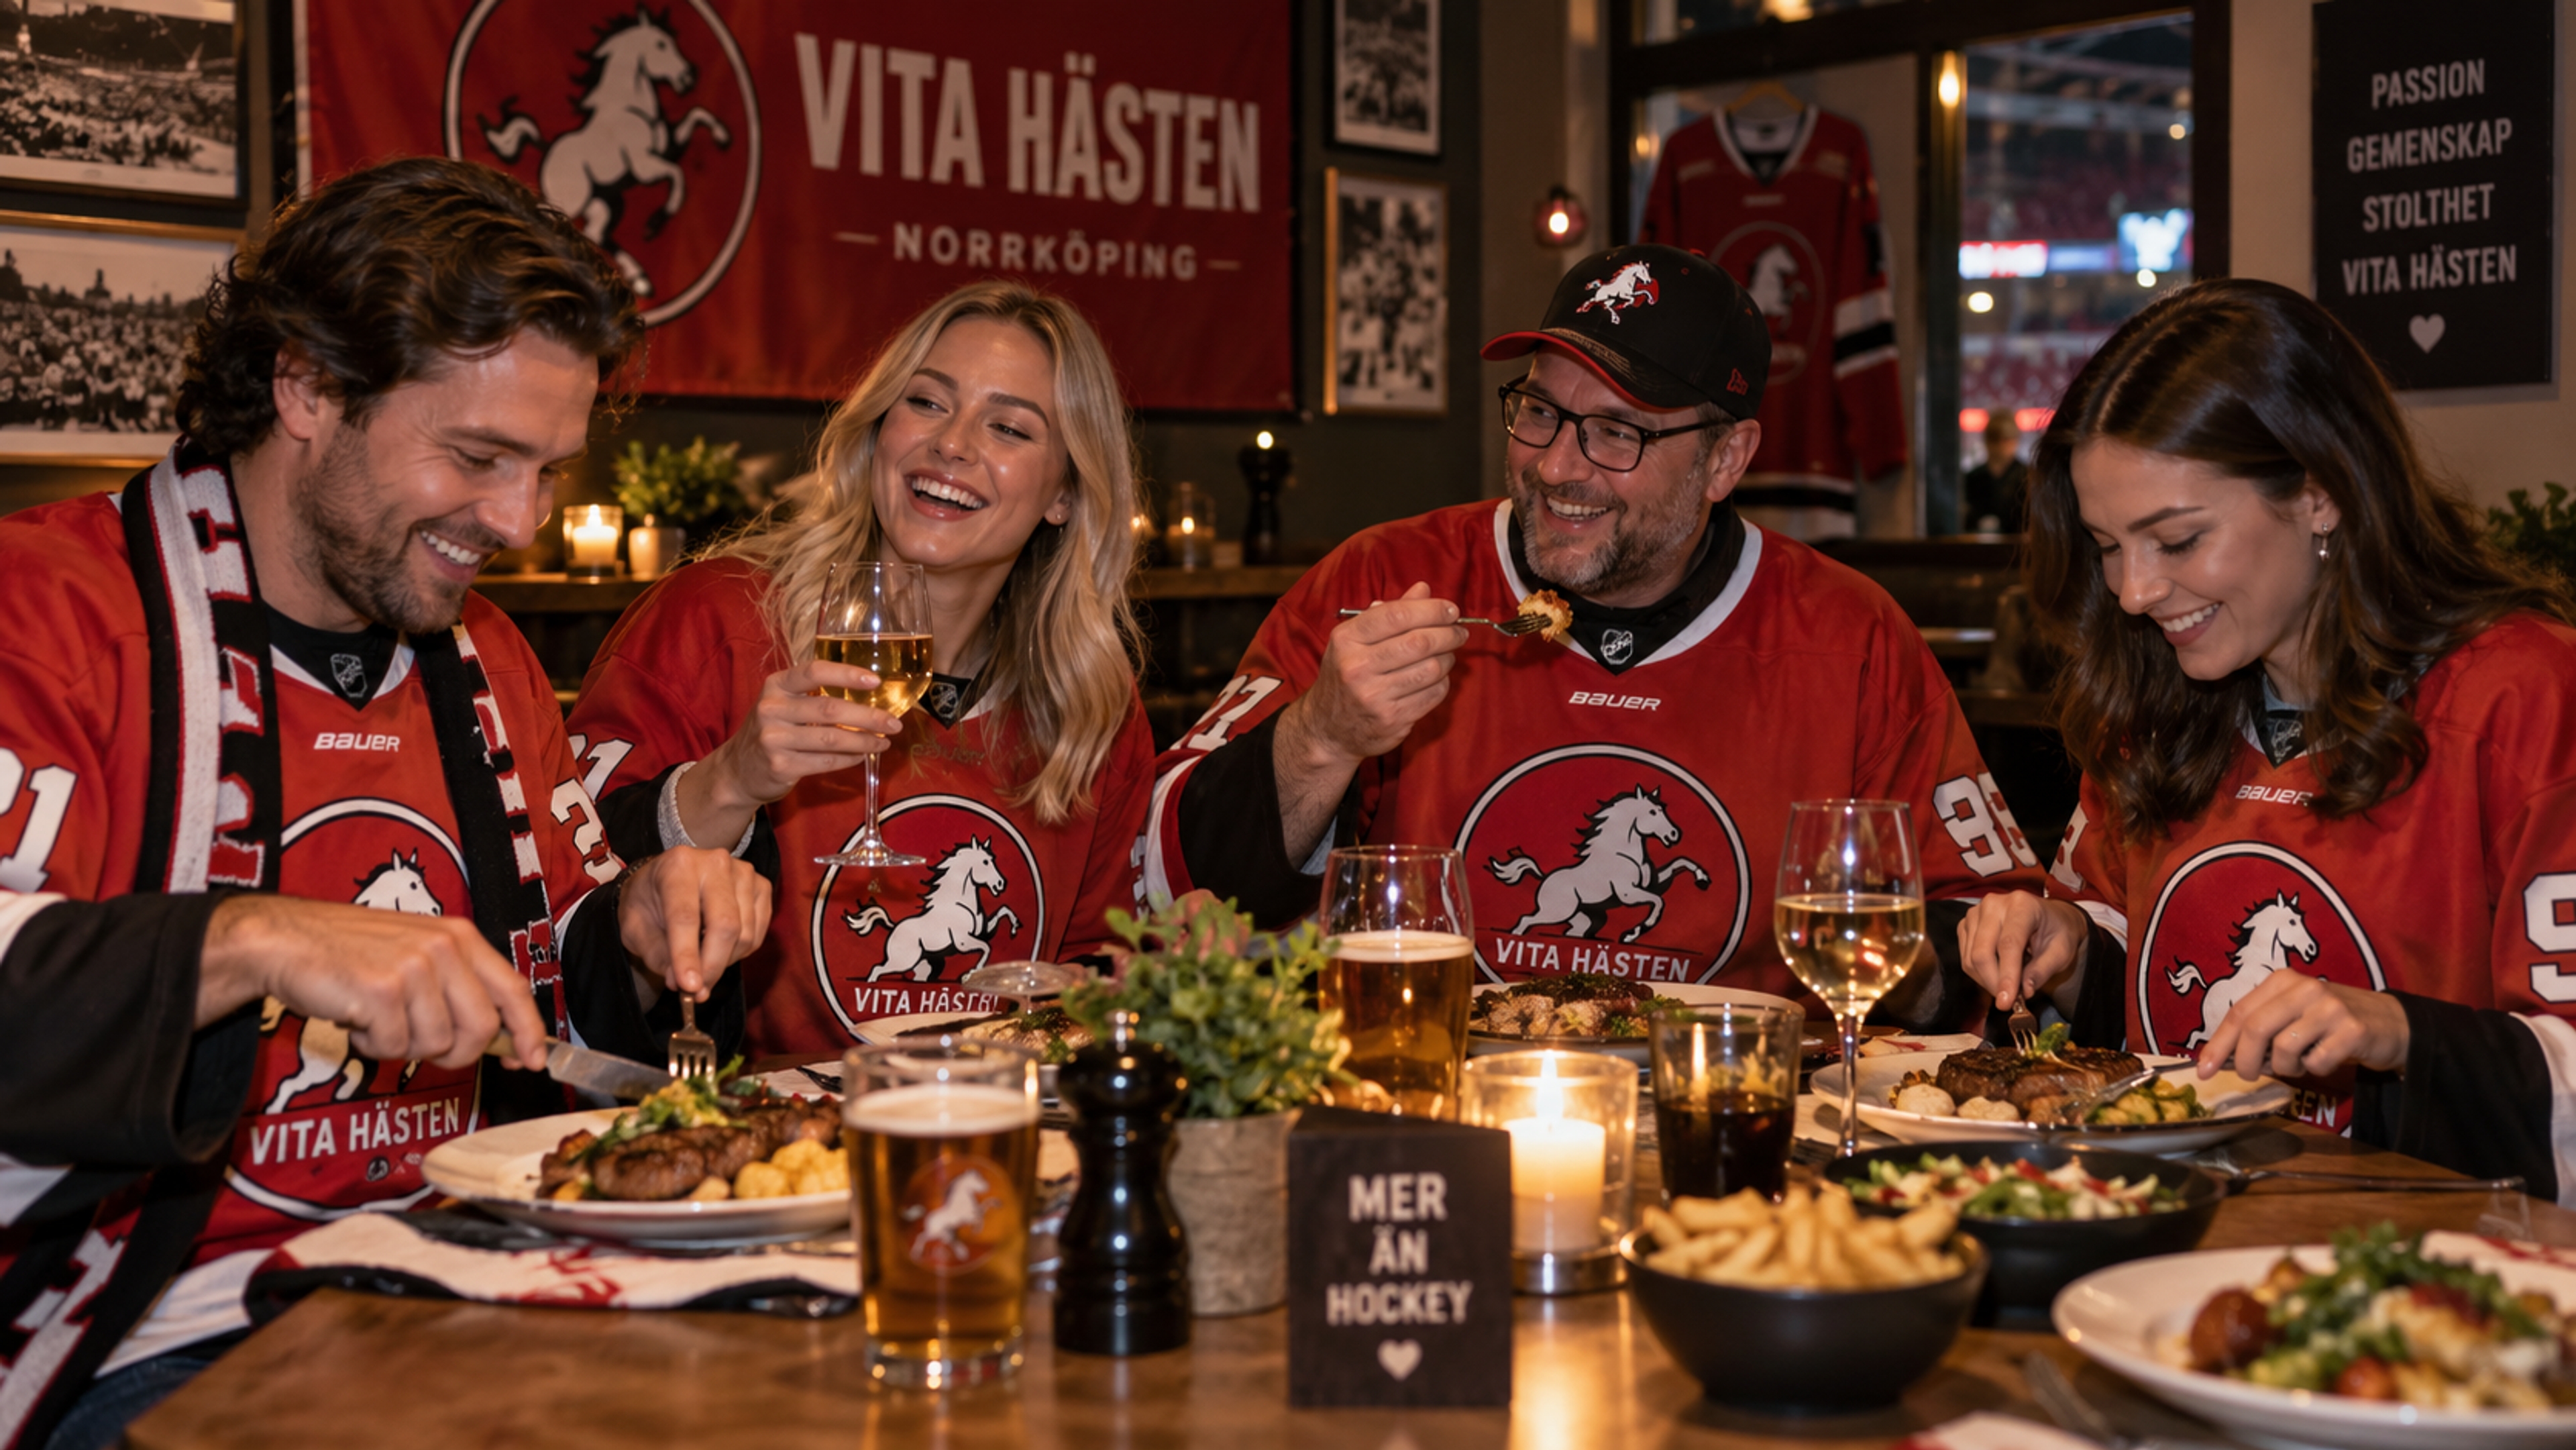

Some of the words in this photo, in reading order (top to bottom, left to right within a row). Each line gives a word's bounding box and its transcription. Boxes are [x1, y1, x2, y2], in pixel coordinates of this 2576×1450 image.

[2371, 58, 2485, 110] PASSION
[795, 32, 985, 189] VITA
[1007, 51, 1260, 213] HÄSTEN
[2347, 117, 2513, 173] GEMENSKAP
[2363, 183, 2496, 233] STOLTHET
[893, 222, 1197, 280] NORRKÖPING
[2342, 255, 2402, 297] VITA
[2410, 244, 2517, 291] HÄSTEN
[569, 733, 635, 802] 1
[1496, 937, 1560, 971] VITA
[1570, 943, 1690, 982] HÄSTEN
[854, 987, 911, 1014] VITA
[250, 1117, 337, 1166] VITA
[349, 1096, 460, 1152] HÄSTEN
[1348, 1171, 1449, 1223] MER
[1368, 1223, 1429, 1276] ÄN
[1326, 1279, 1474, 1327] HOCKEY
